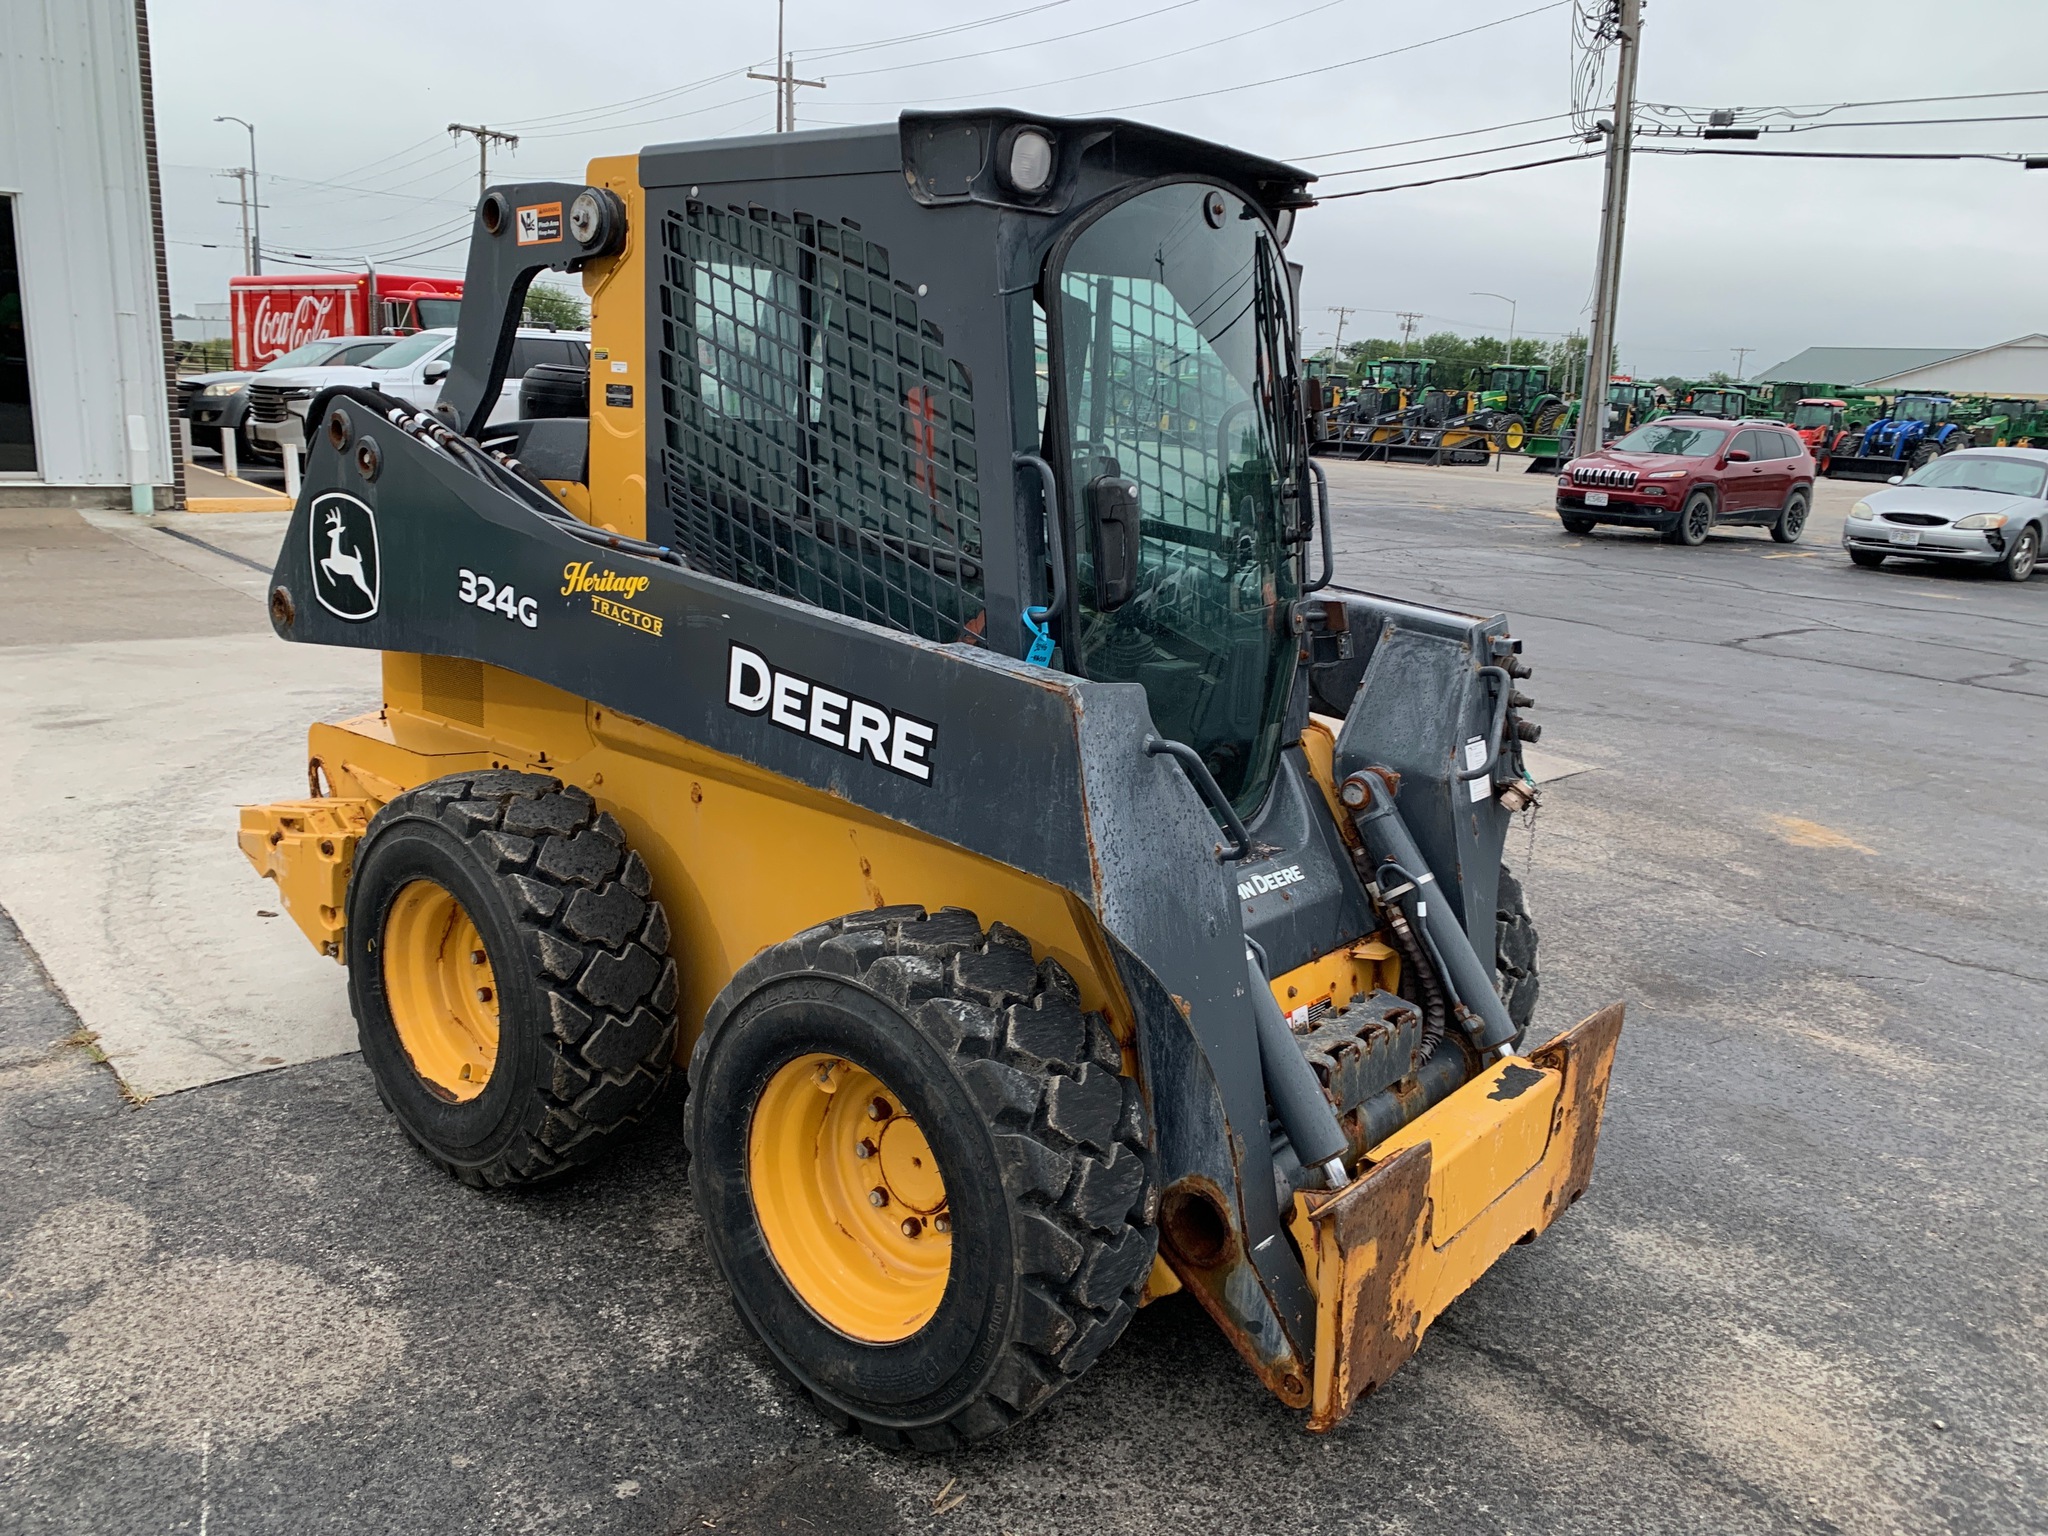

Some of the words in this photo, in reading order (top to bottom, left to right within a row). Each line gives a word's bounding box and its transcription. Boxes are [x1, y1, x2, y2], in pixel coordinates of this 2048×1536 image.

[457, 569, 539, 628] 324G
[560, 560, 651, 599] Heritage
[591, 597, 664, 636] TRACTOR
[728, 644, 935, 781] DEERE
[1250, 864, 1306, 894] DEERE
[736, 979, 842, 1030] GALAXY
